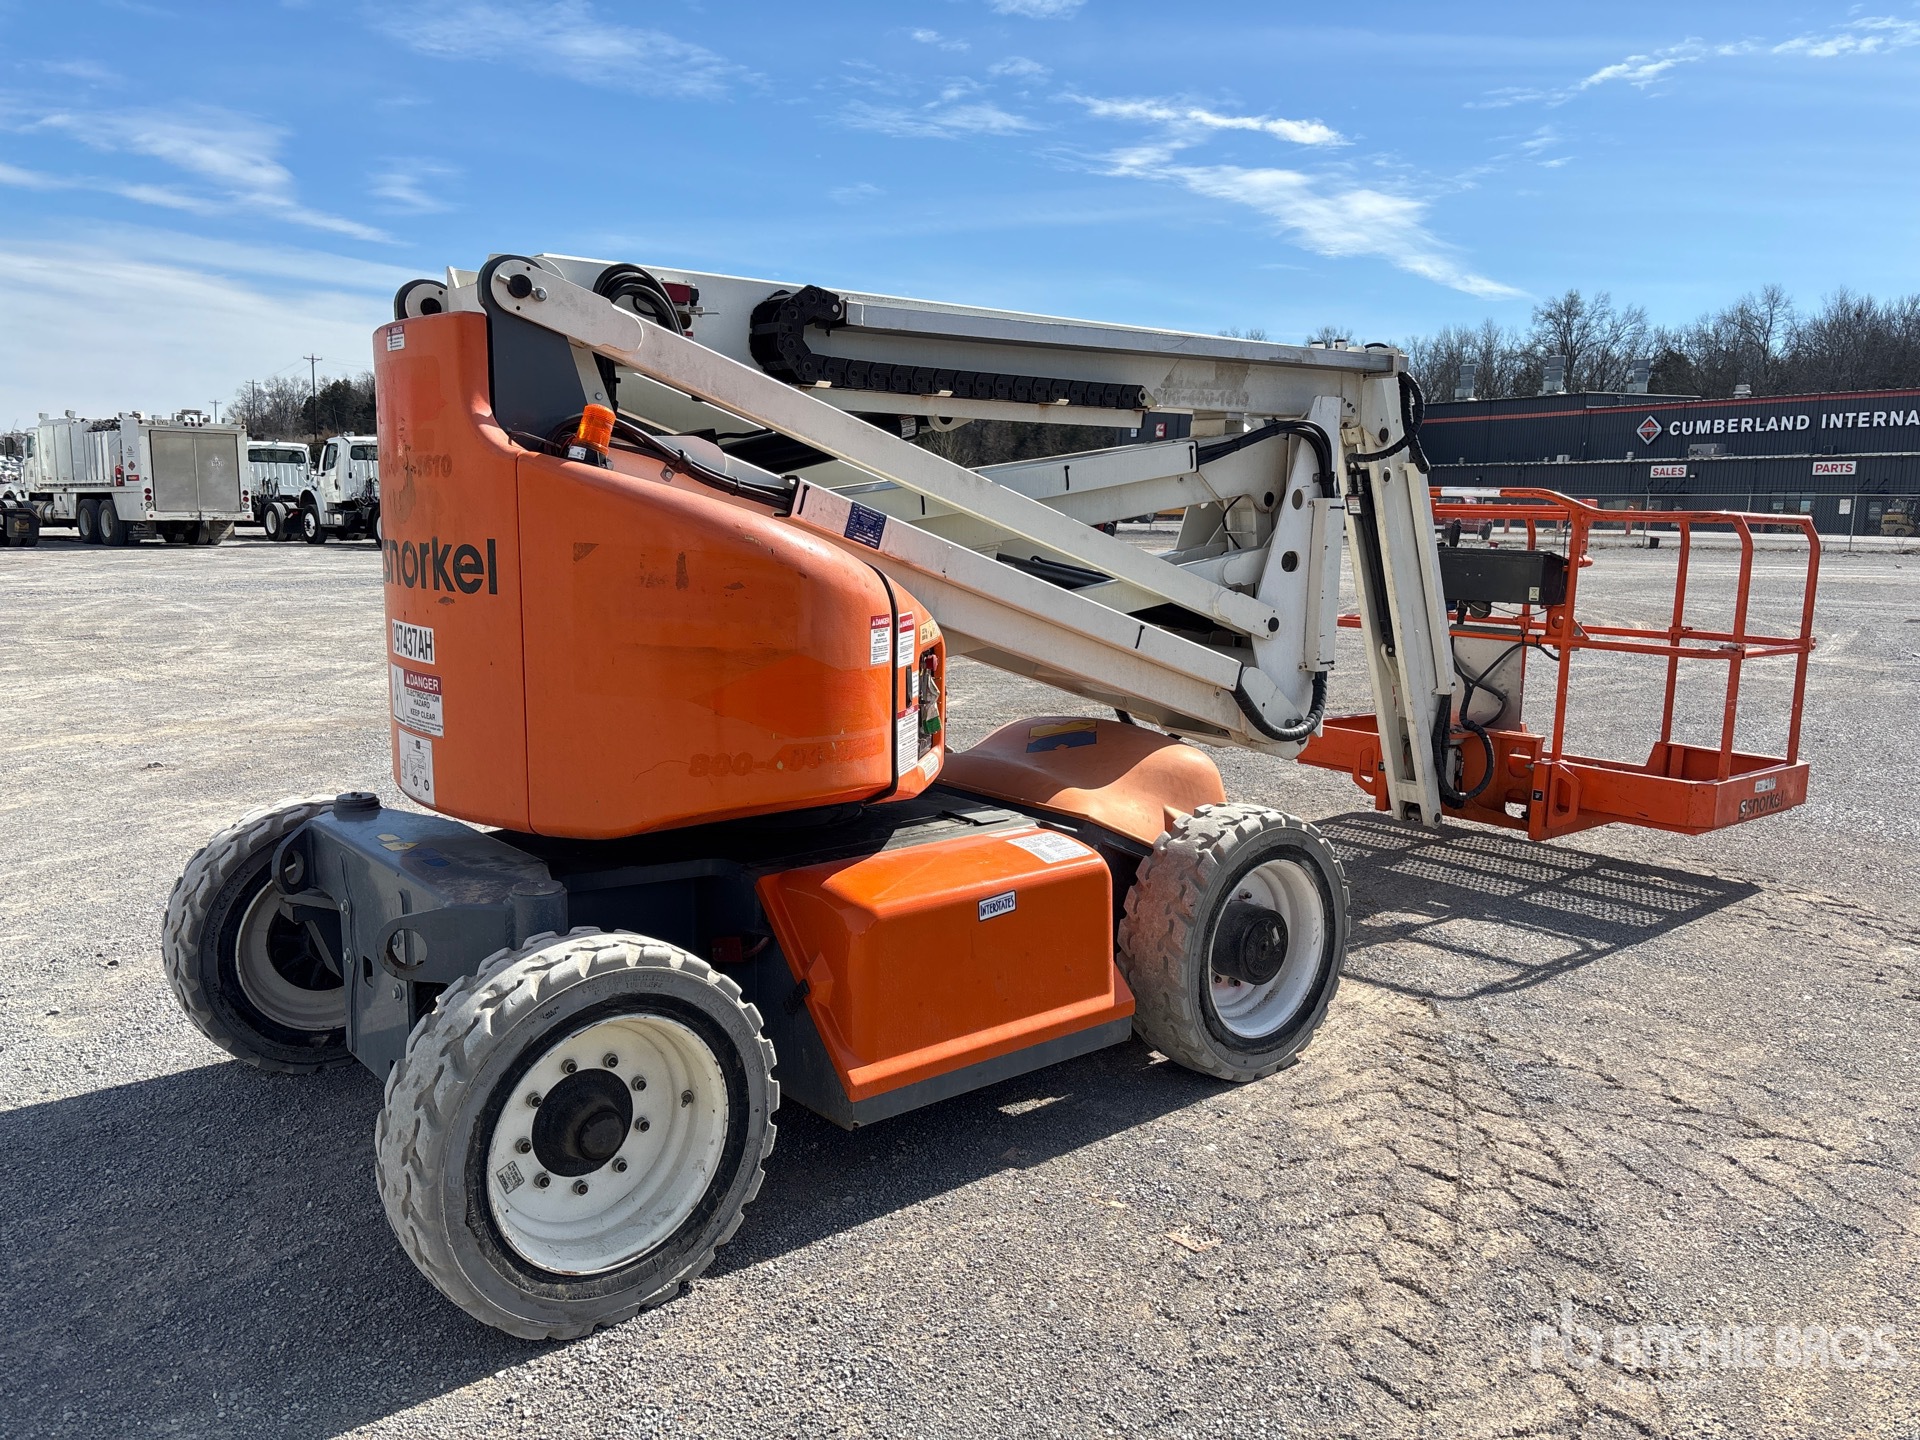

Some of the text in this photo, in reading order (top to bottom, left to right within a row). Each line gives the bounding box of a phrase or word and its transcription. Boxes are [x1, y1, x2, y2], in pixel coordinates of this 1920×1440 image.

[1669, 409, 1920, 436] CUMBERLAND INTERNA
[1652, 467, 1685, 476] SALES
[1815, 463, 1853, 473] PARTS
[382, 536, 498, 595] snorkel
[409, 673, 439, 691] DANGER
[406, 688, 440, 703] ELECTROCUTION
[414, 698, 430, 709] HAZARD
[410, 708, 436, 720] KEEP CLEAR
[980, 895, 1015, 917] INTERSTATES
